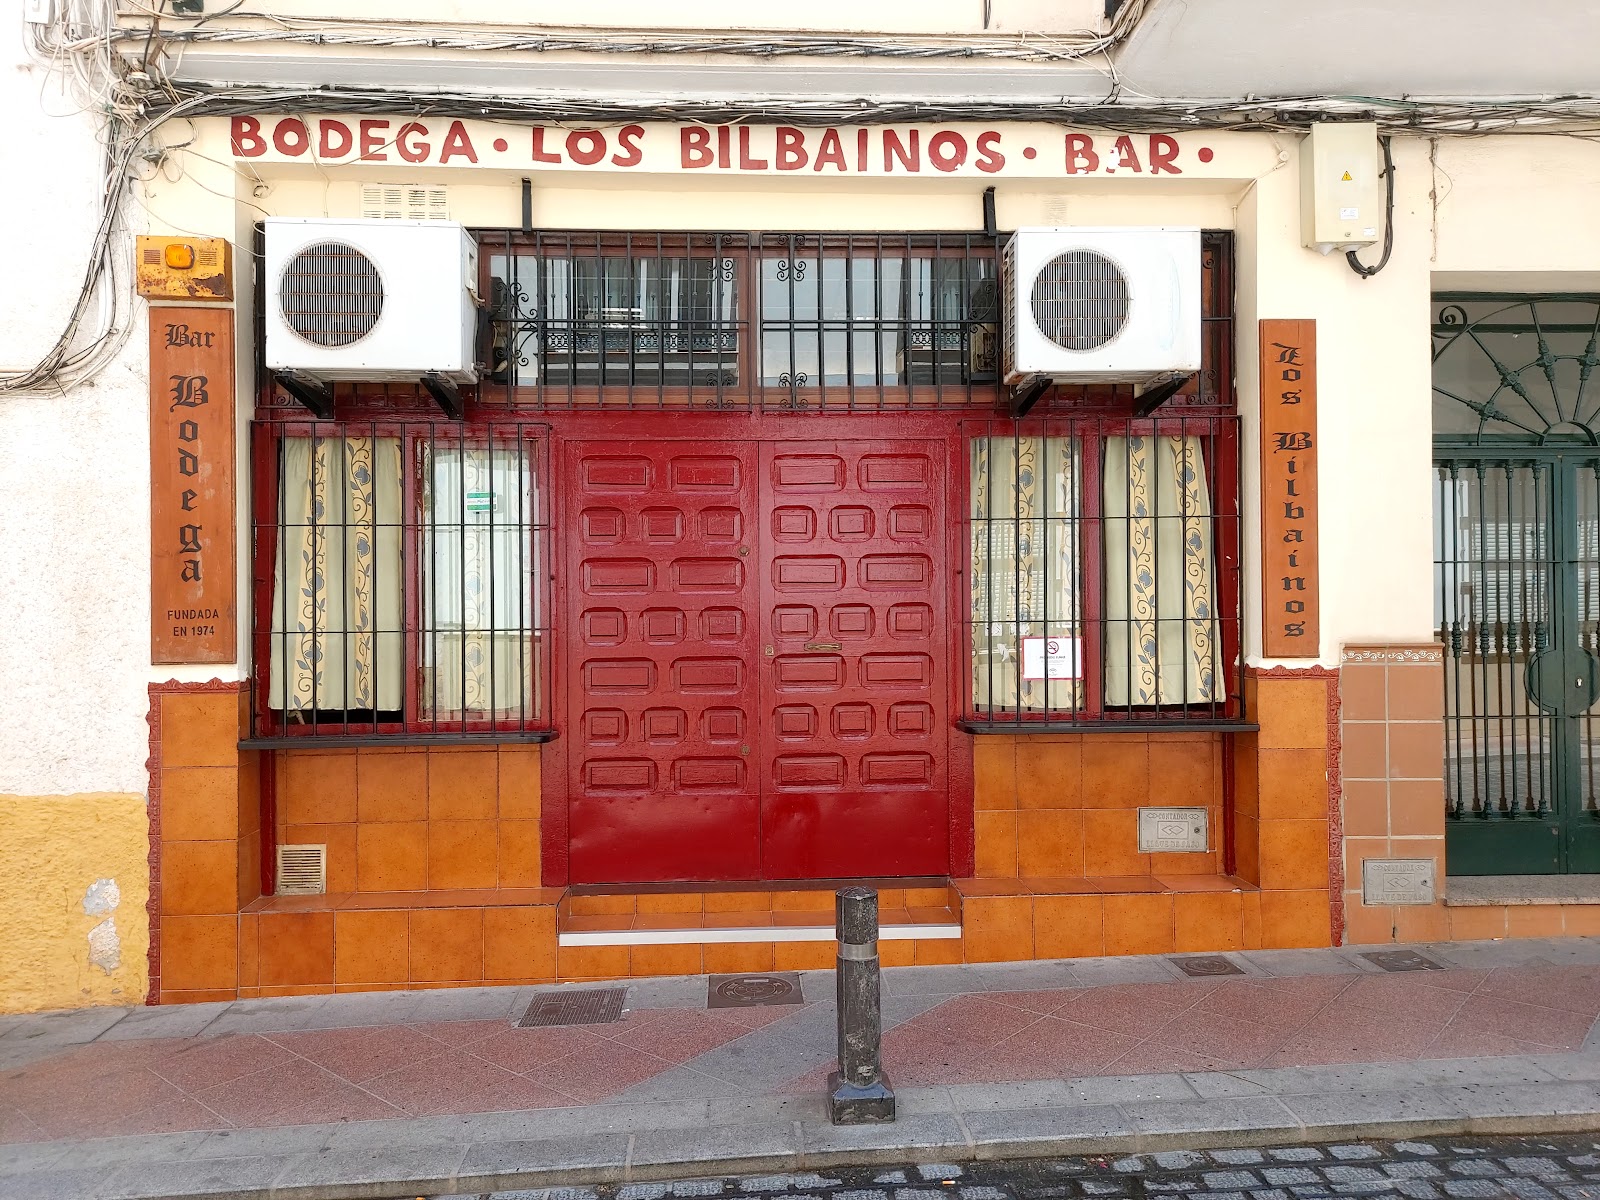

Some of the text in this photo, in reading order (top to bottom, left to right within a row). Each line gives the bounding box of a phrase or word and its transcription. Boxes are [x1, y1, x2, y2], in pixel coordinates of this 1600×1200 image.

[231, 116, 1182, 176] BODEGA LOS BILBAINOS BAR
[164, 323, 216, 349] Bar
[1271, 342, 1304, 405] Los
[169, 374, 209, 583] Bodega
[167, 608, 219, 620] FUNDADA
[173, 625, 215, 637] EN 1974
[1158, 812, 1188, 820] CONTADOR
